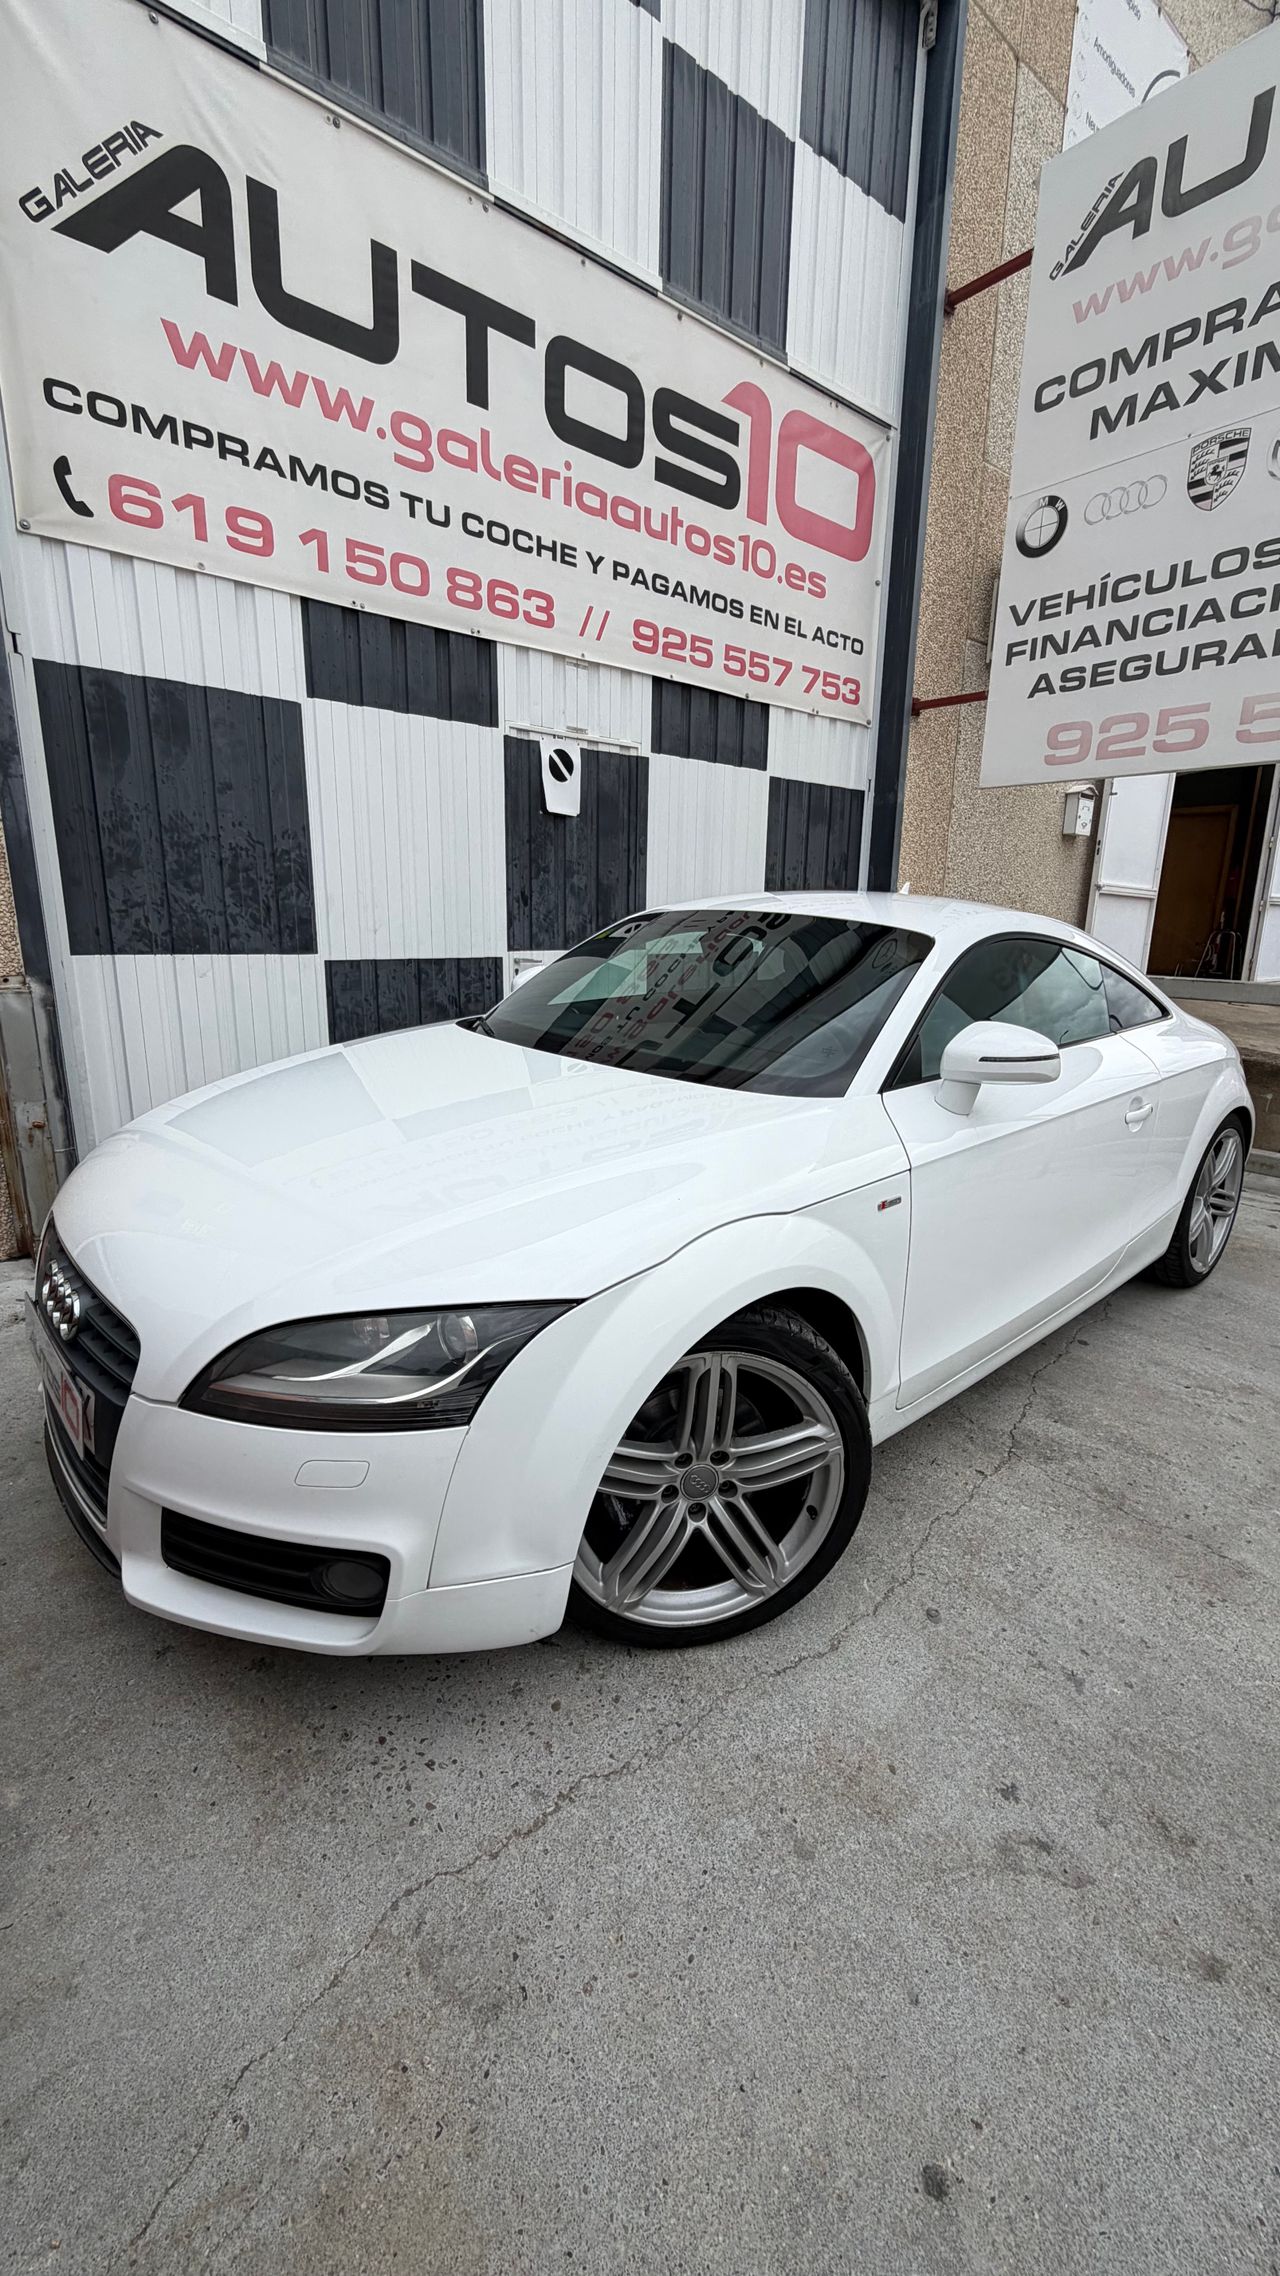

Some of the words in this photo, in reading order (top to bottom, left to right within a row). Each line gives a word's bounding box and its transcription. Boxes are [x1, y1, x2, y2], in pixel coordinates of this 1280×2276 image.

[18, 120, 164, 223] GALERIA
[1049, 171, 1125, 281] GALERIA
[160, 317, 827, 599] www.galeriaautos10.es
[1192, 430, 1250, 454] PORSCHE
[43, 377, 390, 510] COMPRAMOS
[400, 491, 451, 529] TU
[461, 512, 578, 568] COCHE
[585, 551, 605, 575] Y
[612, 560, 744, 619] PAGAMOS
[750, 604, 780, 630] EN
[784, 616, 808, 640] EL
[812, 626, 865, 656] ACTO
[107, 473, 275, 558] 619
[298, 527, 431, 598] 150
[446, 567, 556, 629] 863
[632, 618, 714, 669] 925
[723, 644, 793, 687] 557
[801, 665, 861, 706] 753
[1009, 537, 1280, 627] VEHÍCULOS
[1043, 702, 1212, 767] 925
[1235, 692, 1280, 744] 5
